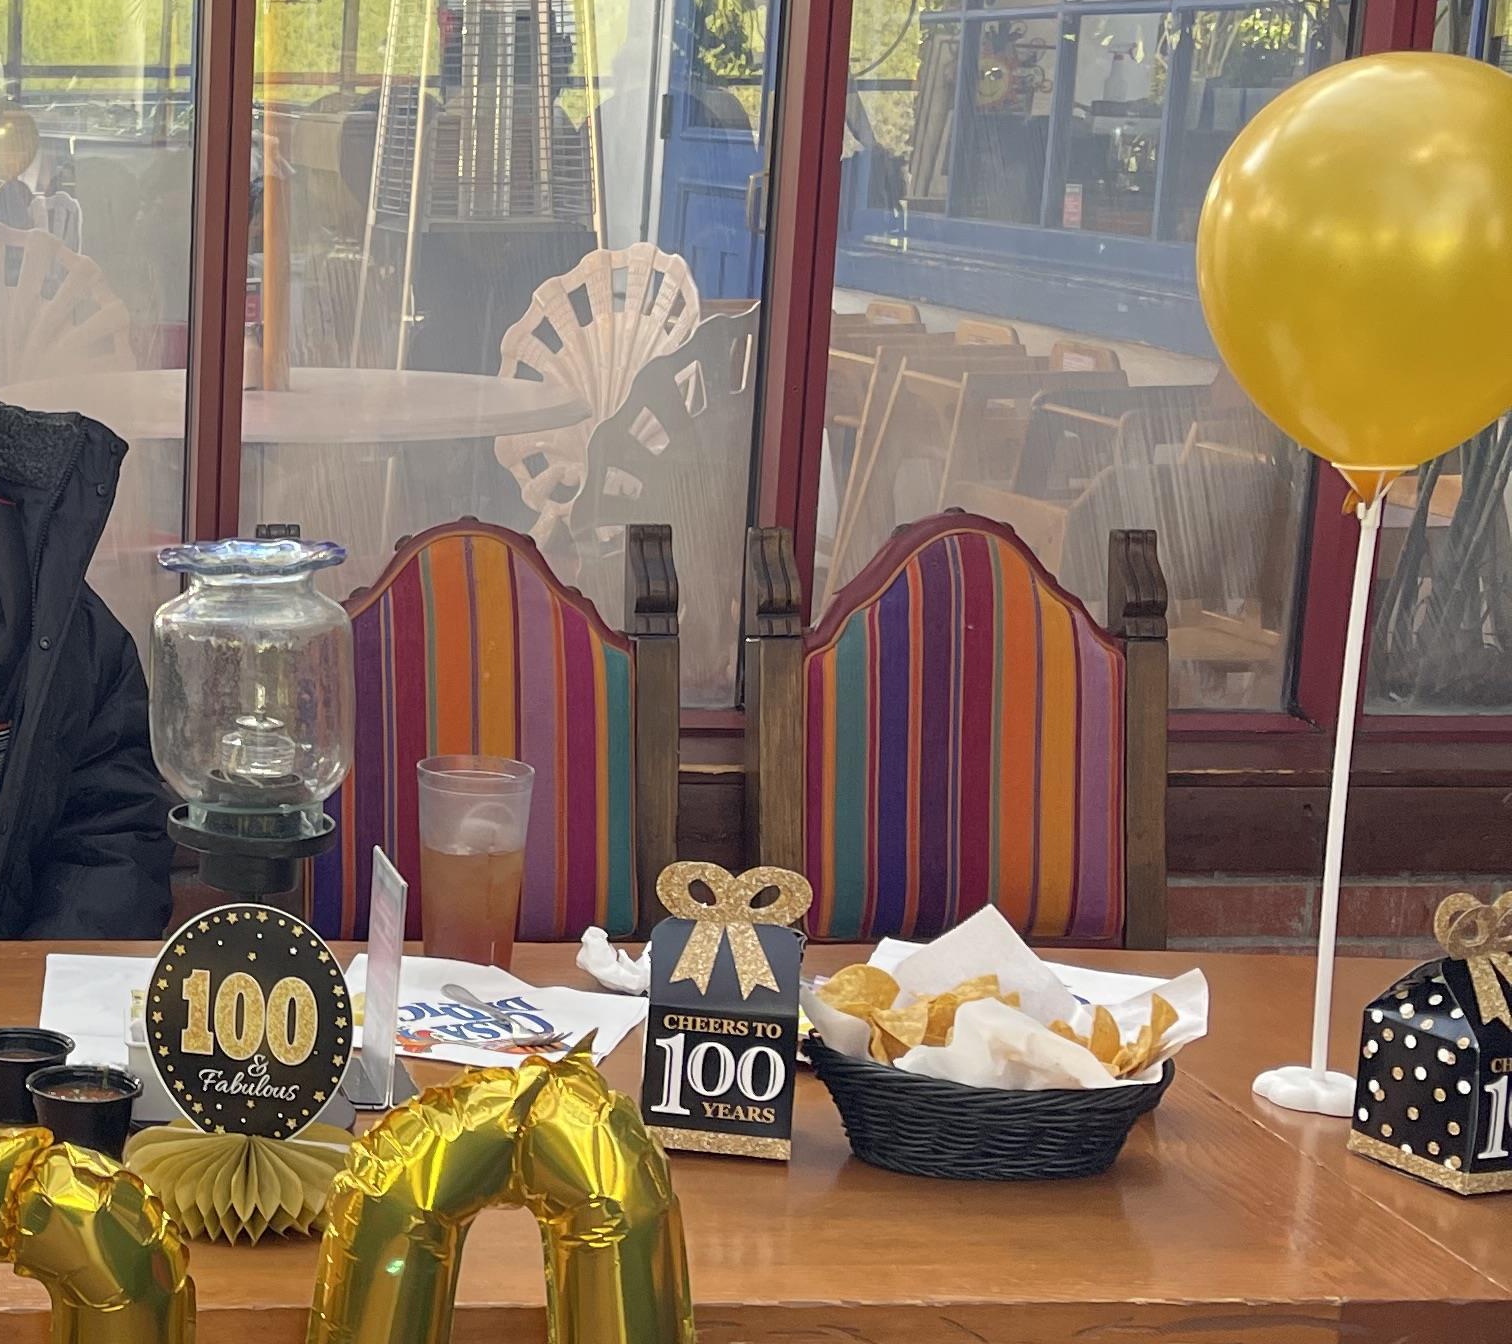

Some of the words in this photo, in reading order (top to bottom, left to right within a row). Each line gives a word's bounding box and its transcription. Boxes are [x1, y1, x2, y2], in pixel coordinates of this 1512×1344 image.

[180, 969, 319, 1066] 100
[663, 1014, 749, 1036] CHEERS
[755, 1021, 782, 1039] TO
[247, 1054, 268, 1078] &
[650, 1032, 786, 1116] 100
[198, 1068, 300, 1102] Fabulous
[702, 1102, 776, 1124] YEARS
